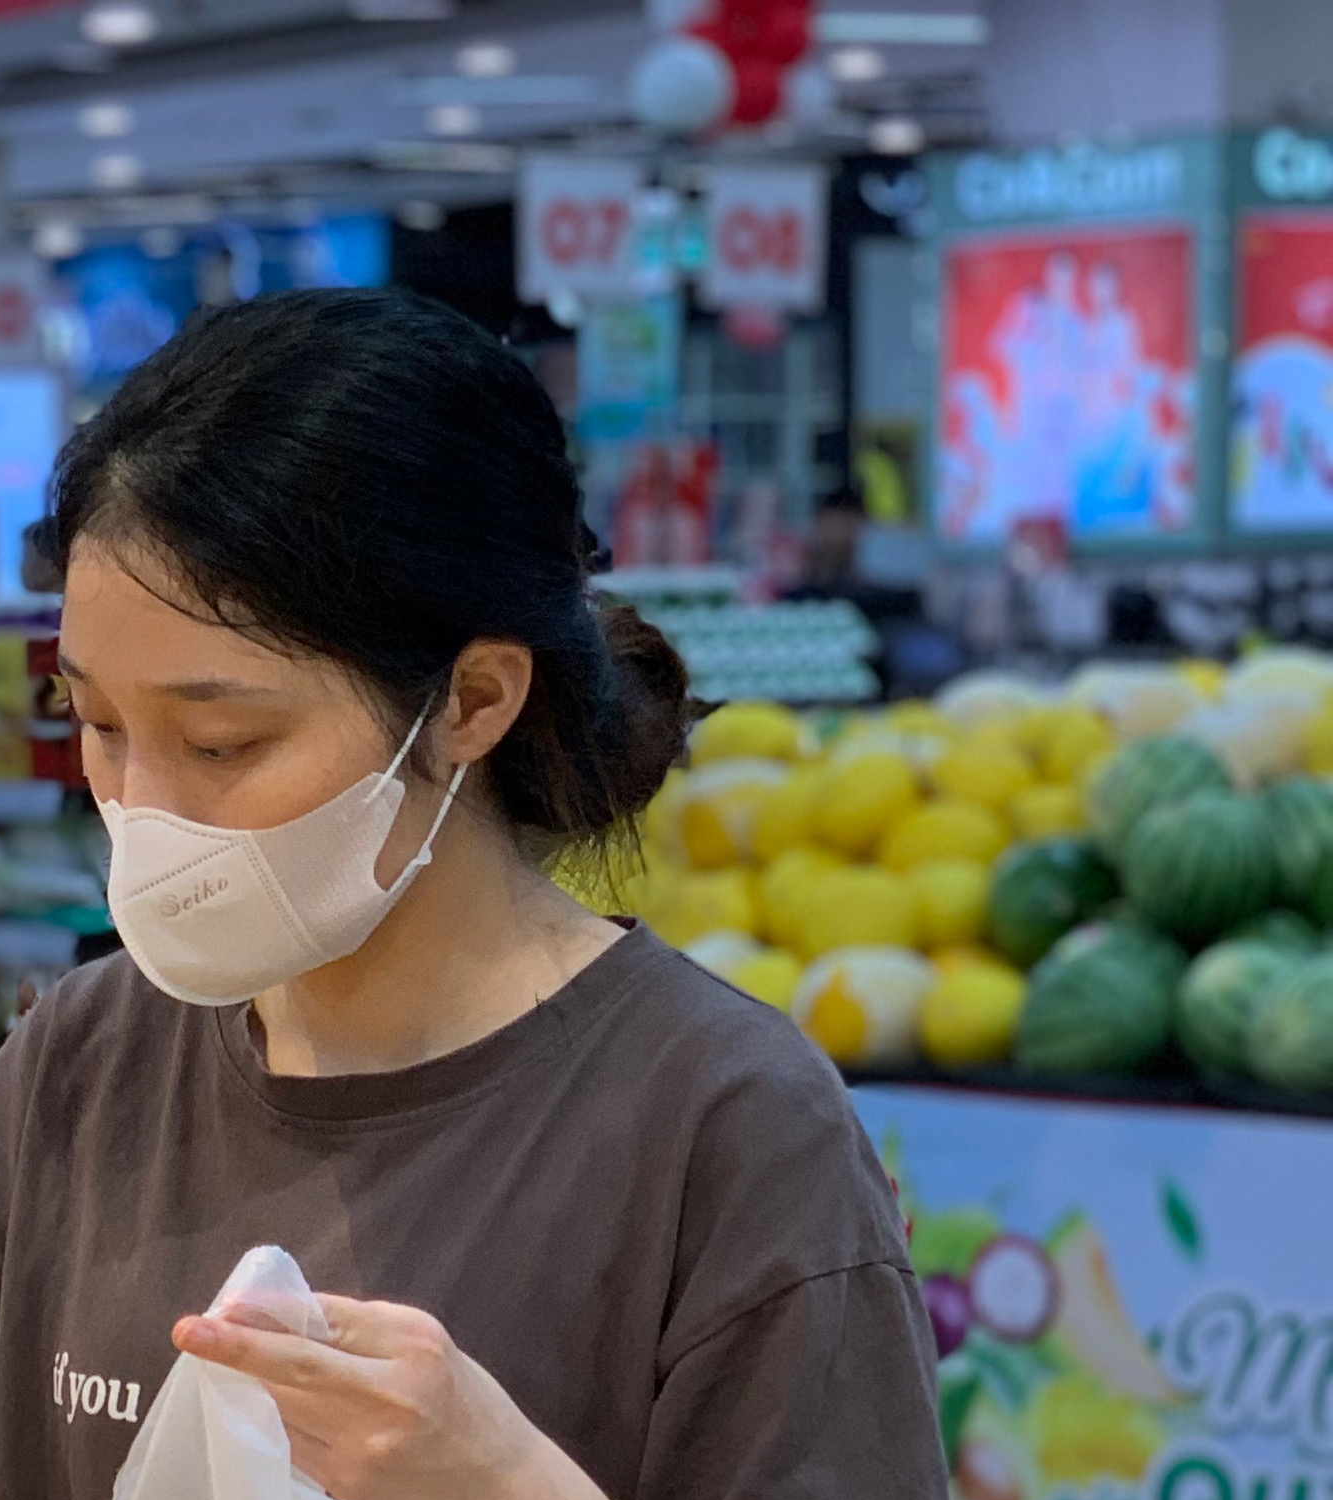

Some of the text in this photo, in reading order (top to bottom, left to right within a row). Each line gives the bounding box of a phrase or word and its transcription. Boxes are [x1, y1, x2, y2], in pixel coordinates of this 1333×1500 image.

[539, 200, 630, 270] 07
[716, 202, 805, 278] 08
[159, 877, 229, 918] Seiko
[66, 1370, 141, 1424] you
